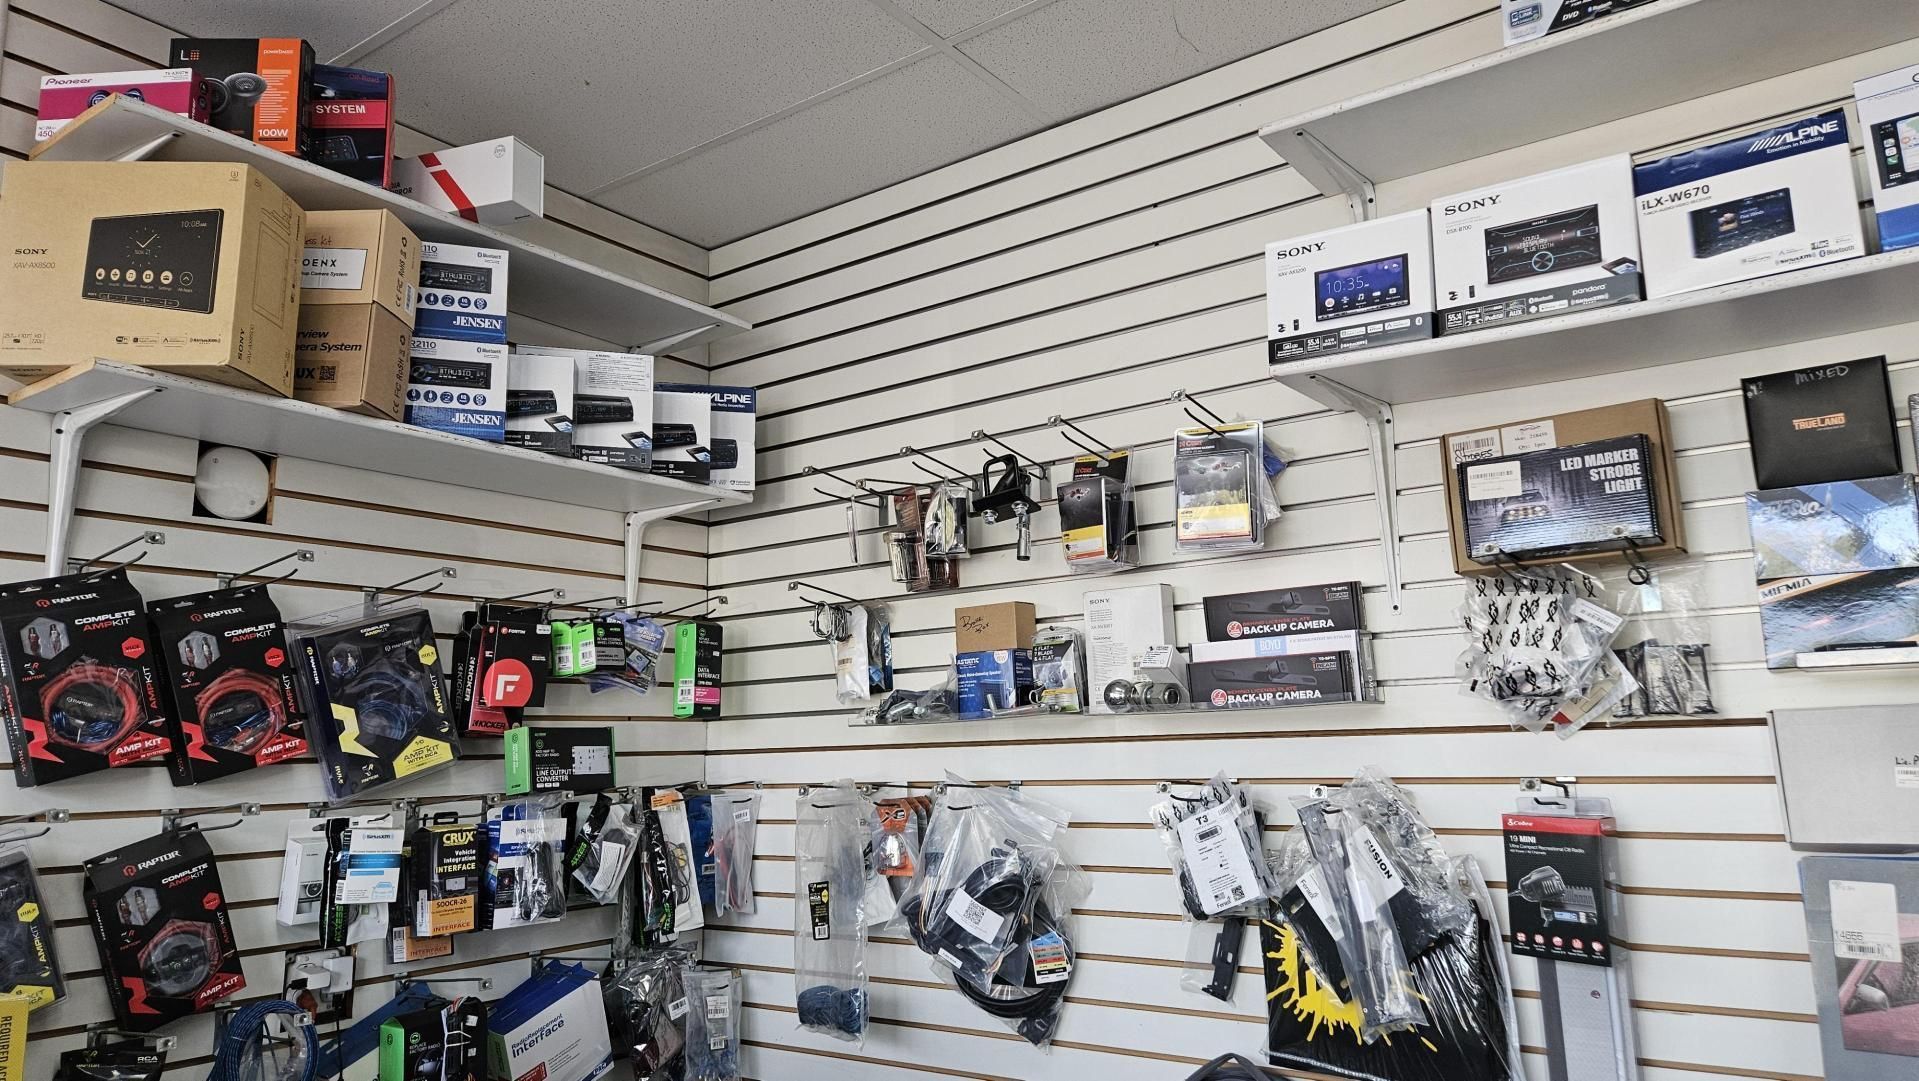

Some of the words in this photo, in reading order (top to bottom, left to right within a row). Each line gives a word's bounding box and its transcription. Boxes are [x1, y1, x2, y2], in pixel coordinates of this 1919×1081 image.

[1562, 11, 1579, 21] DVD
[316, 105, 366, 114] SYSTEM
[1779, 120, 1839, 144] ALPINE
[1766, 144, 1792, 154] Emotion
[1800, 135, 1824, 146] Mobility
[1444, 195, 1501, 216] SONY
[1642, 185, 1710, 211] iLX-W670
[1277, 242, 1326, 260] SONY
[1826, 246, 1855, 256] Bluetooth
[1327, 276, 1364, 294] 10:35
[1572, 284, 1606, 295] pandora
[453, 315, 502, 329] JENSEN
[297, 343, 318, 351] era
[320, 343, 362, 352] System
[711, 393, 752, 404] ALPINE
[451, 413, 501, 426] JENSEN
[1560, 457, 1583, 472] LED
[1585, 448, 1639, 468] MARKER
[1590, 464, 1641, 482] STROBE
[1605, 478, 1642, 495] LIGHT
[52, 593, 100, 605] RAPTOR
[75, 610, 136, 625] COMPLETE
[203, 607, 245, 619] RAPTOR
[82, 618, 131, 632] AMPKIT
[224, 622, 276, 637] COMPLETE
[360, 623, 390, 633] COMPLETE
[1244, 623, 1287, 635] BACK-UP
[1291, 619, 1334, 631] CAMERA
[231, 630, 272, 643] AMPKIT
[1260, 640, 1281, 651] BOYO
[143, 666, 158, 709] AMPKIT
[465, 666, 475, 702] KICKER
[283, 674, 296, 713] AMPKIT
[429, 673, 444, 714] AMPKIT
[1228, 692, 1273, 703] BACK-UP
[1277, 690, 1321, 700] CAMERA
[478, 720, 506, 728] KICKER
[115, 743, 143, 755] AMP
[145, 737, 163, 748] KIT
[261, 745, 284, 756] AMP
[285, 739, 301, 748] KIT
[403, 750, 425, 761] AMP
[425, 744, 440, 753] KIT
[407, 755, 424, 764] WITH
[424, 751, 438, 759] RCA
[1196, 815, 1208, 825] T3
[443, 832, 474, 844] CRUX
[138, 850, 183, 870] RAPTOR
[443, 855, 476, 863] Integration
[1364, 839, 1392, 879] FUSION
[161, 862, 209, 884] COMPLETE
[436, 863, 476, 874] INTERFACE
[168, 870, 206, 888] AMPKIT
[433, 921, 471, 932] INTERFACE
[31, 925, 47, 962] AMPKIT
[410, 946, 448, 956] INTERFACE
[199, 984, 222, 999] AMP
[224, 976, 239, 987] KIT
[0, 1015, 12, 1063] REQUIRED
[512, 1014, 563, 1049] RadioReplacement
[512, 1019, 565, 1058] Interface
